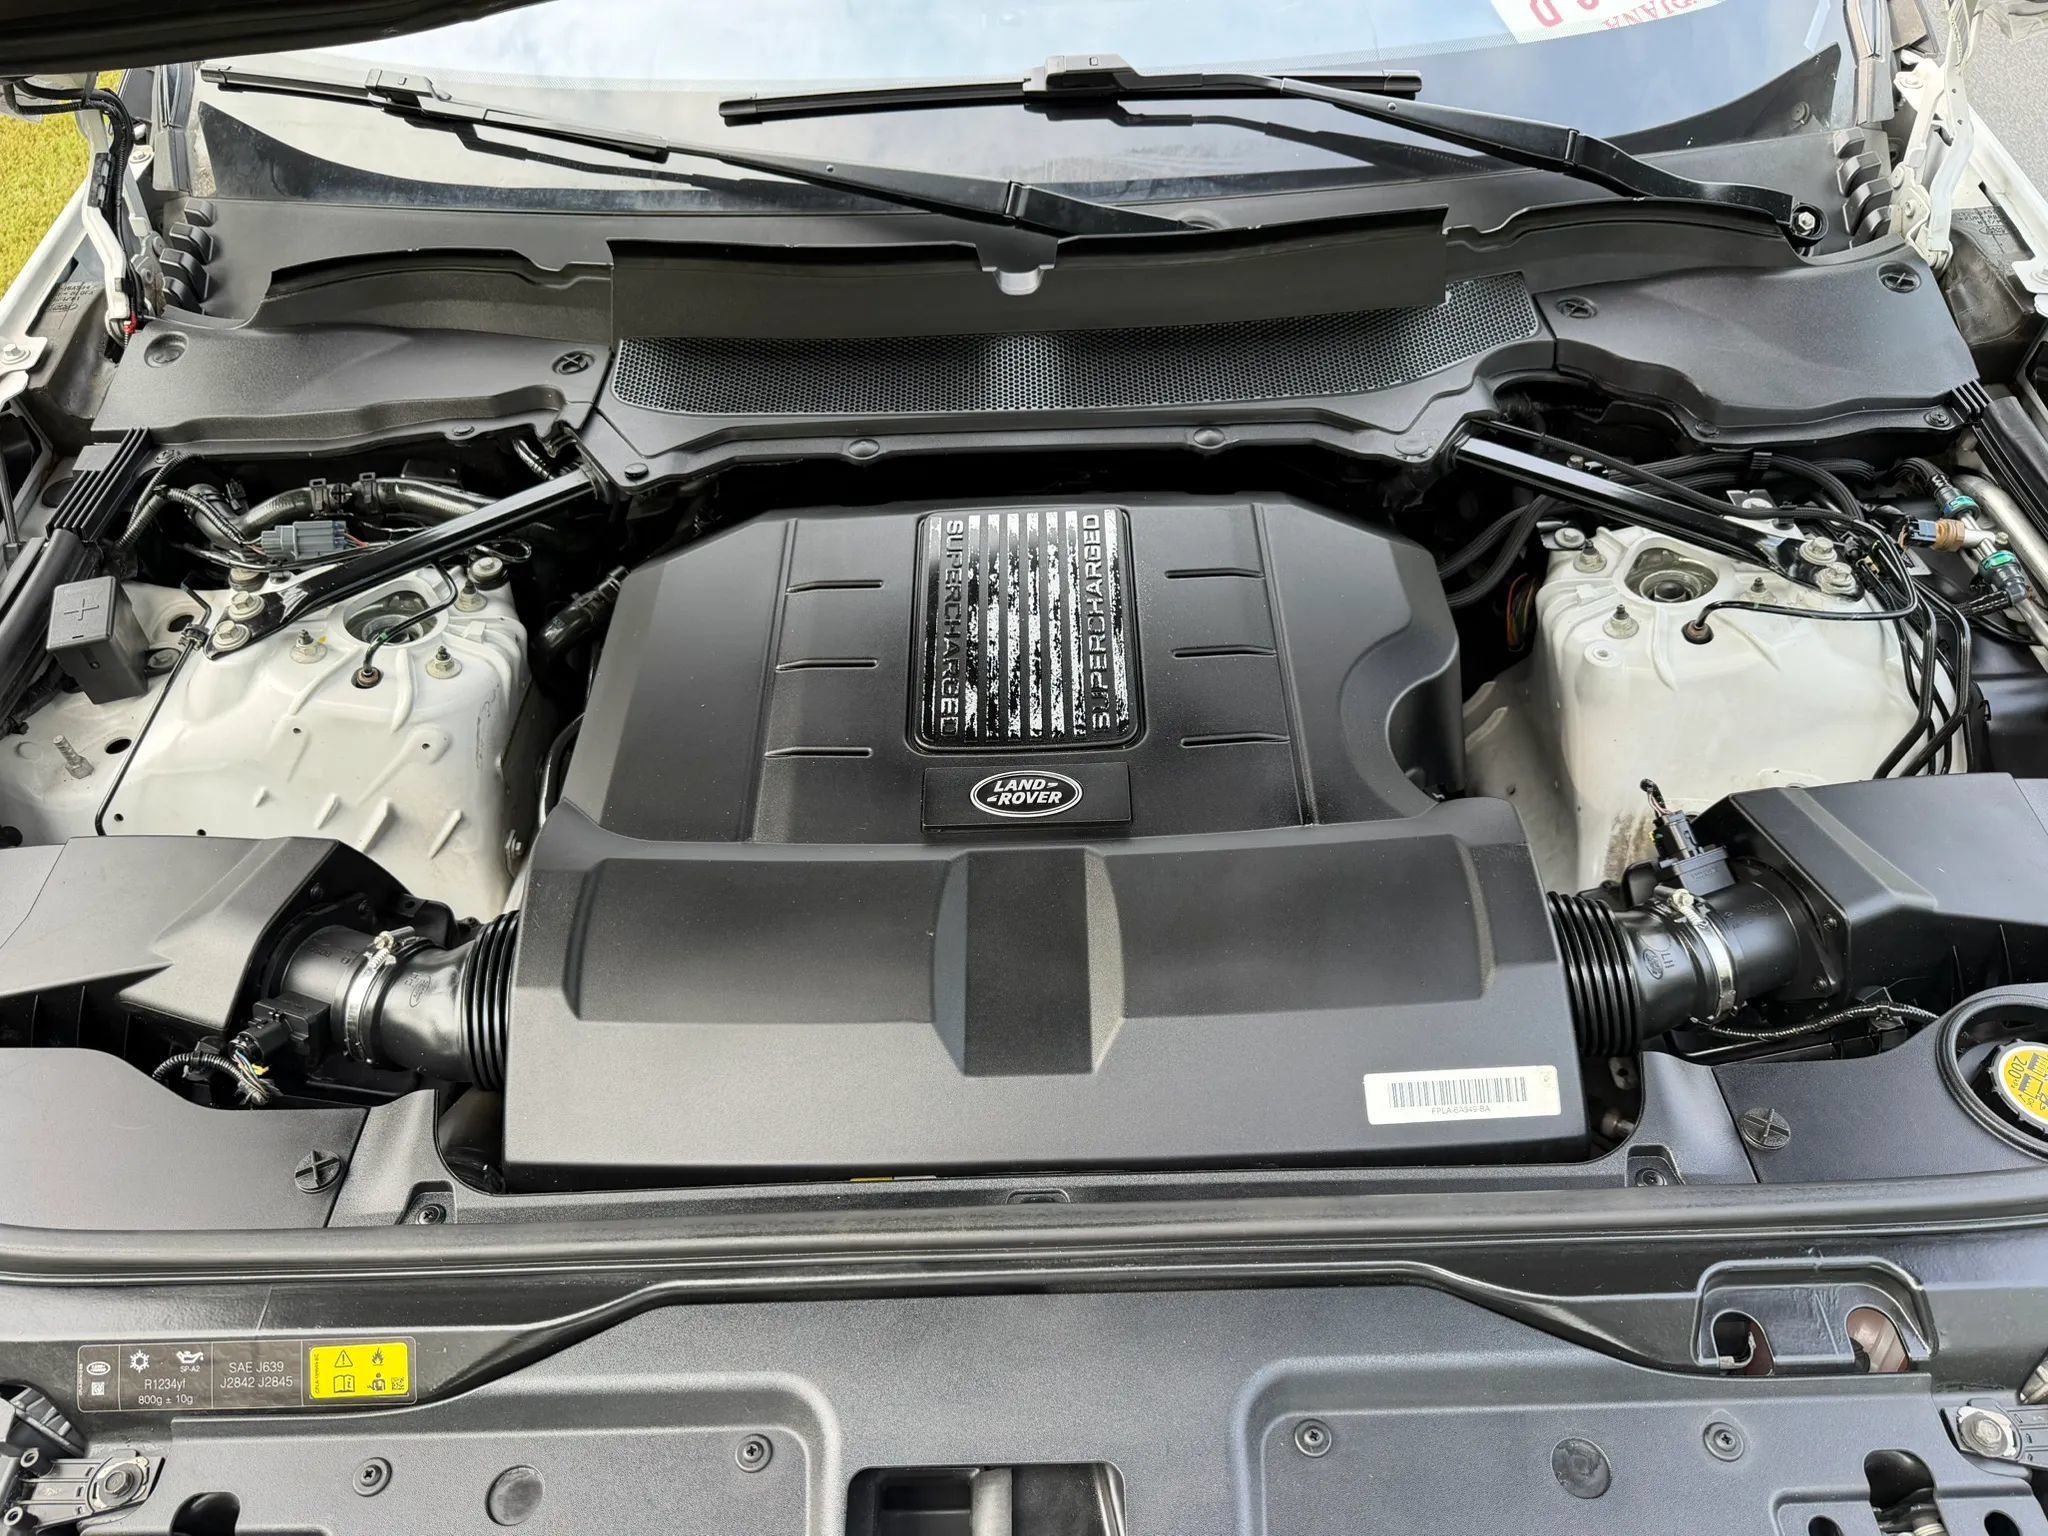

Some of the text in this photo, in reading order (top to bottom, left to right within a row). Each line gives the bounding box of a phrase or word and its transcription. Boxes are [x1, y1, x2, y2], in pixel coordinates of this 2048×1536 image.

[940, 519, 965, 737] SUPERCHARGED
[1082, 514, 1111, 731] SUPERCHARGED
[993, 779, 1047, 793] LAND
[997, 791, 1063, 806] ROVER
[2008, 1056, 2027, 1079] 200
[229, 1361, 284, 1374] SAE J639
[144, 1378, 187, 1392] R1234yf
[220, 1376, 293, 1389] J2842 J2845
[138, 1395, 163, 1406] 800g
[175, 1394, 194, 1405] 10g
